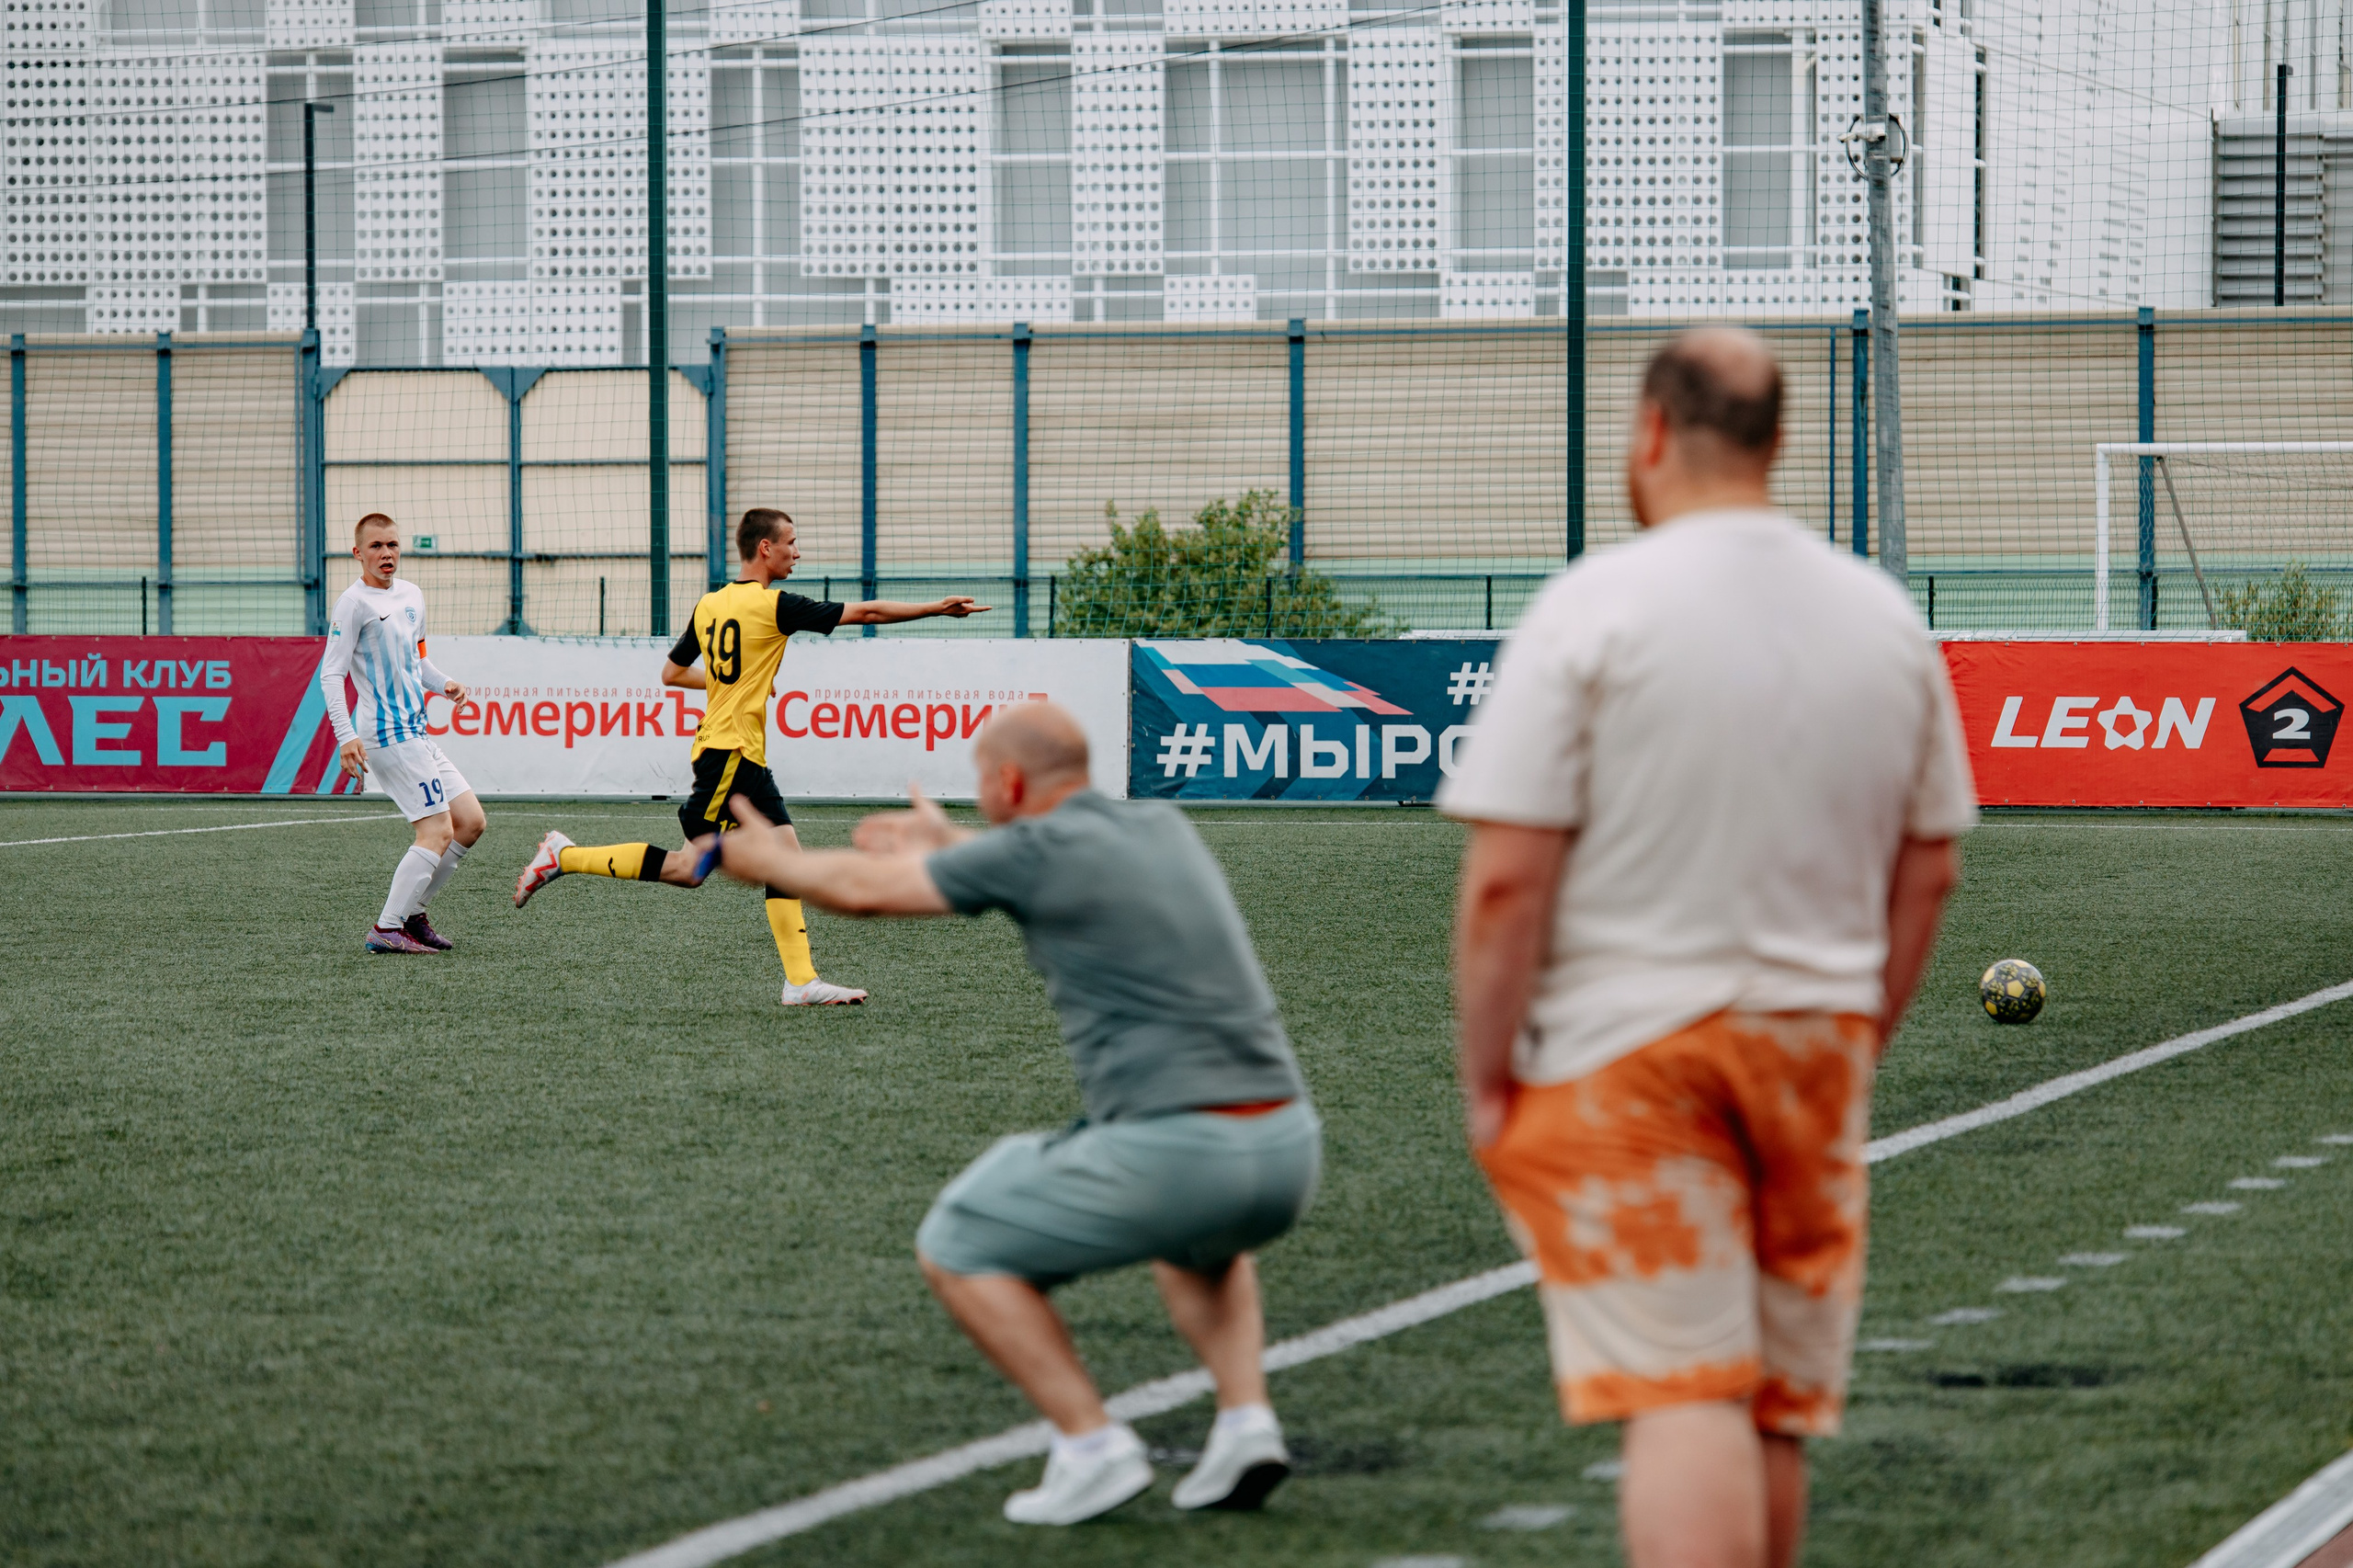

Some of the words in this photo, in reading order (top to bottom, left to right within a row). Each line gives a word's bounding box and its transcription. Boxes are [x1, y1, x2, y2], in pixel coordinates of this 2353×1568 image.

[706, 618, 741, 685] 19
[123, 660, 232, 688] КЛУБ
[465, 687, 538, 699] риродная
[547, 687, 617, 698] питьевая
[626, 687, 661, 699] вода
[814, 688, 899, 700] природная
[907, 688, 980, 700] питьевая
[988, 689, 1024, 701] вода
[776, 690, 1048, 752] Семери
[1991, 695, 2217, 751] LEON
[2272, 708, 2312, 740] 2
[418, 778, 444, 807] 19
